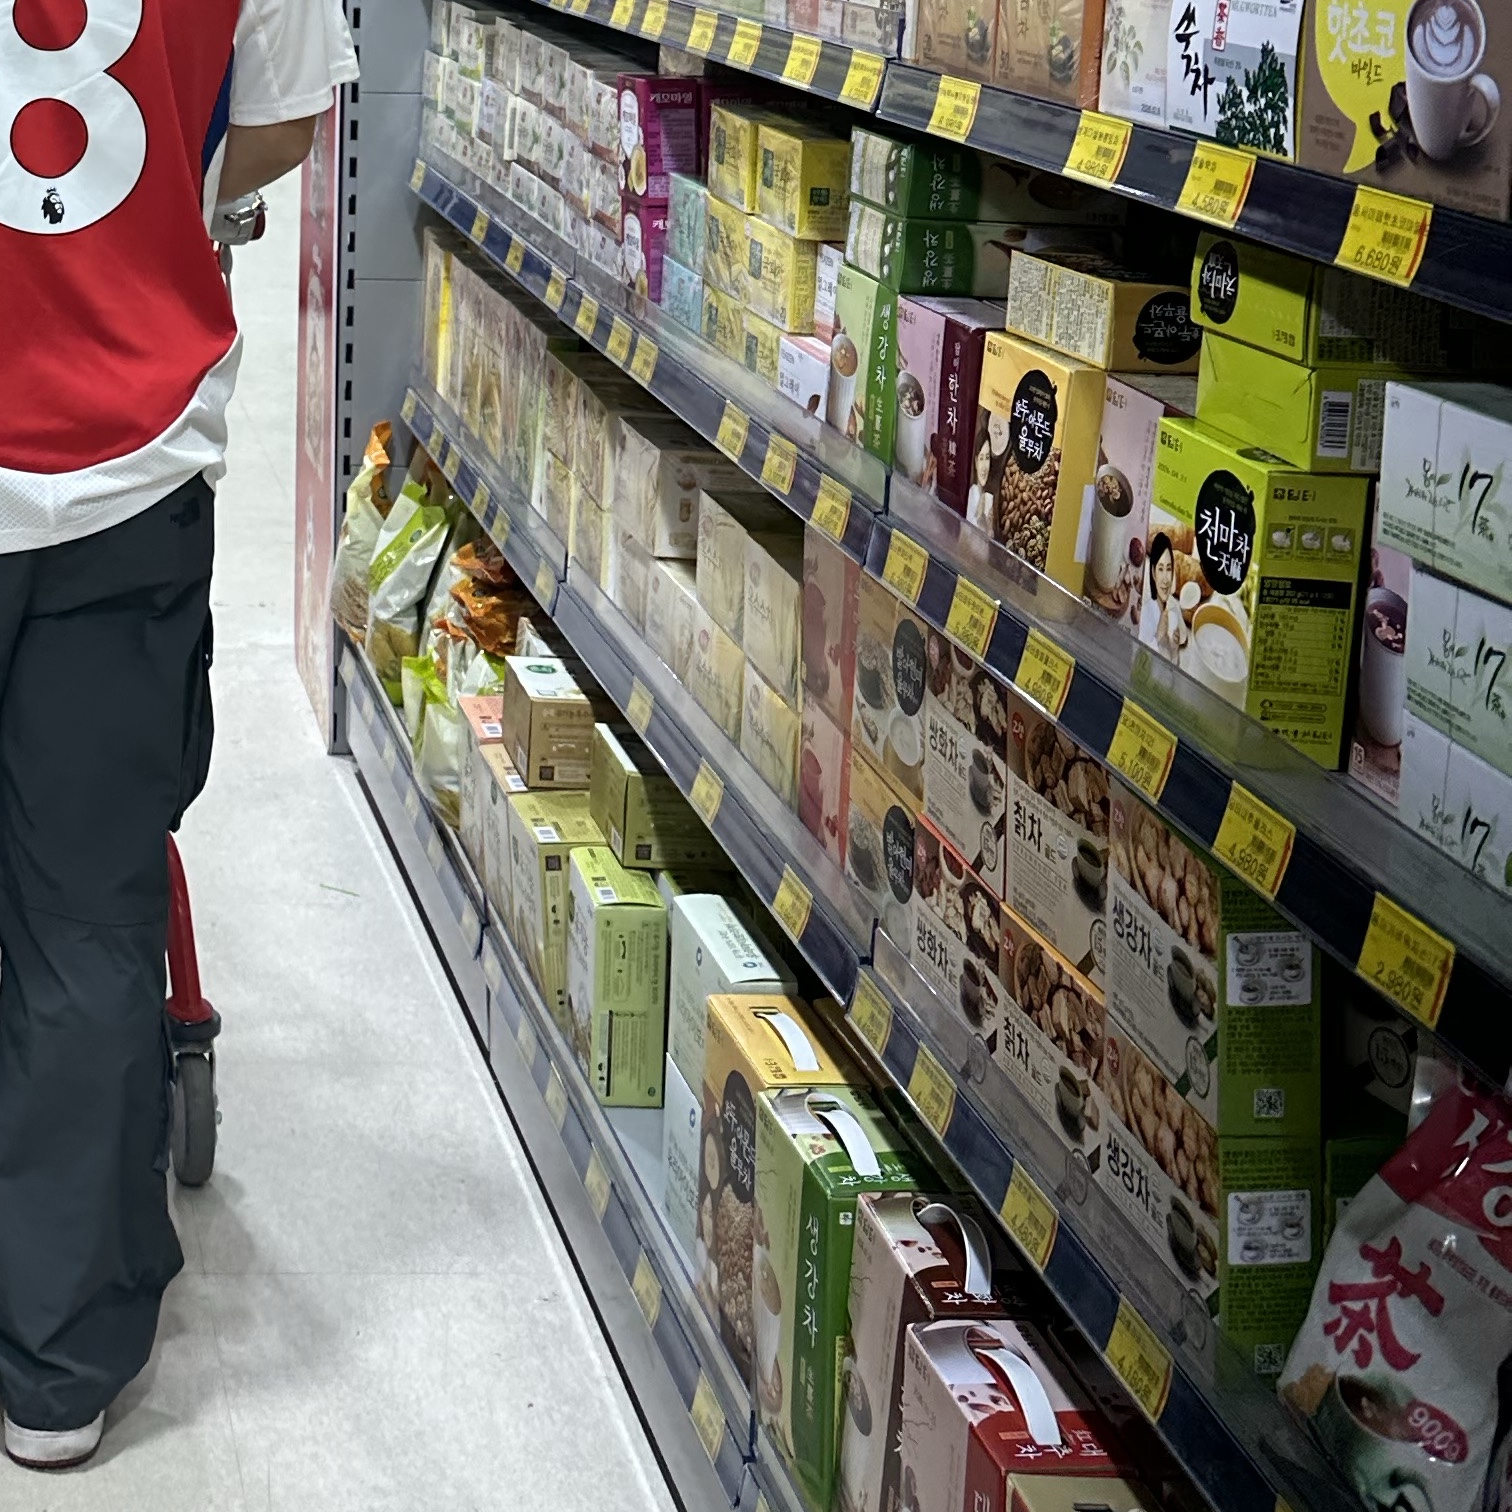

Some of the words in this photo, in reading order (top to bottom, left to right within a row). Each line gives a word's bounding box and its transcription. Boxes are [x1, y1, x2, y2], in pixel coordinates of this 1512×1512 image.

[1328, 2, 1396, 64] 핫초코
[1174, 1, 1216, 122] 쑥차
[1351, 59, 1383, 85] 마일드
[1191, 193, 1227, 217] 4,580원
[1354, 245, 1402, 275] 6,680원
[876, 305, 891, 391] 생강차
[1017, 428, 1044, 461] 율무차
[1458, 462, 1493, 535] 17
[1199, 507, 1249, 561] 천마차
[1218, 553, 1242, 581] 天麻
[1474, 637, 1506, 712] 17
[929, 716, 958, 771] 쌍화차
[1118, 751, 1151, 791] 5,100원
[1013, 800, 1043, 852] 칡차
[1461, 806, 1491, 872] 17
[1228, 843, 1269, 884] 4,980원
[1113, 895, 1152, 969] 생강차
[1376, 961, 1423, 1009] 2,980원
[1106, 1133, 1151, 1213] 생강차
[802, 1215, 819, 1348] 생강차
[1323, 1236, 1444, 1371] 茶
[1408, 1407, 1461, 1463] 900g
